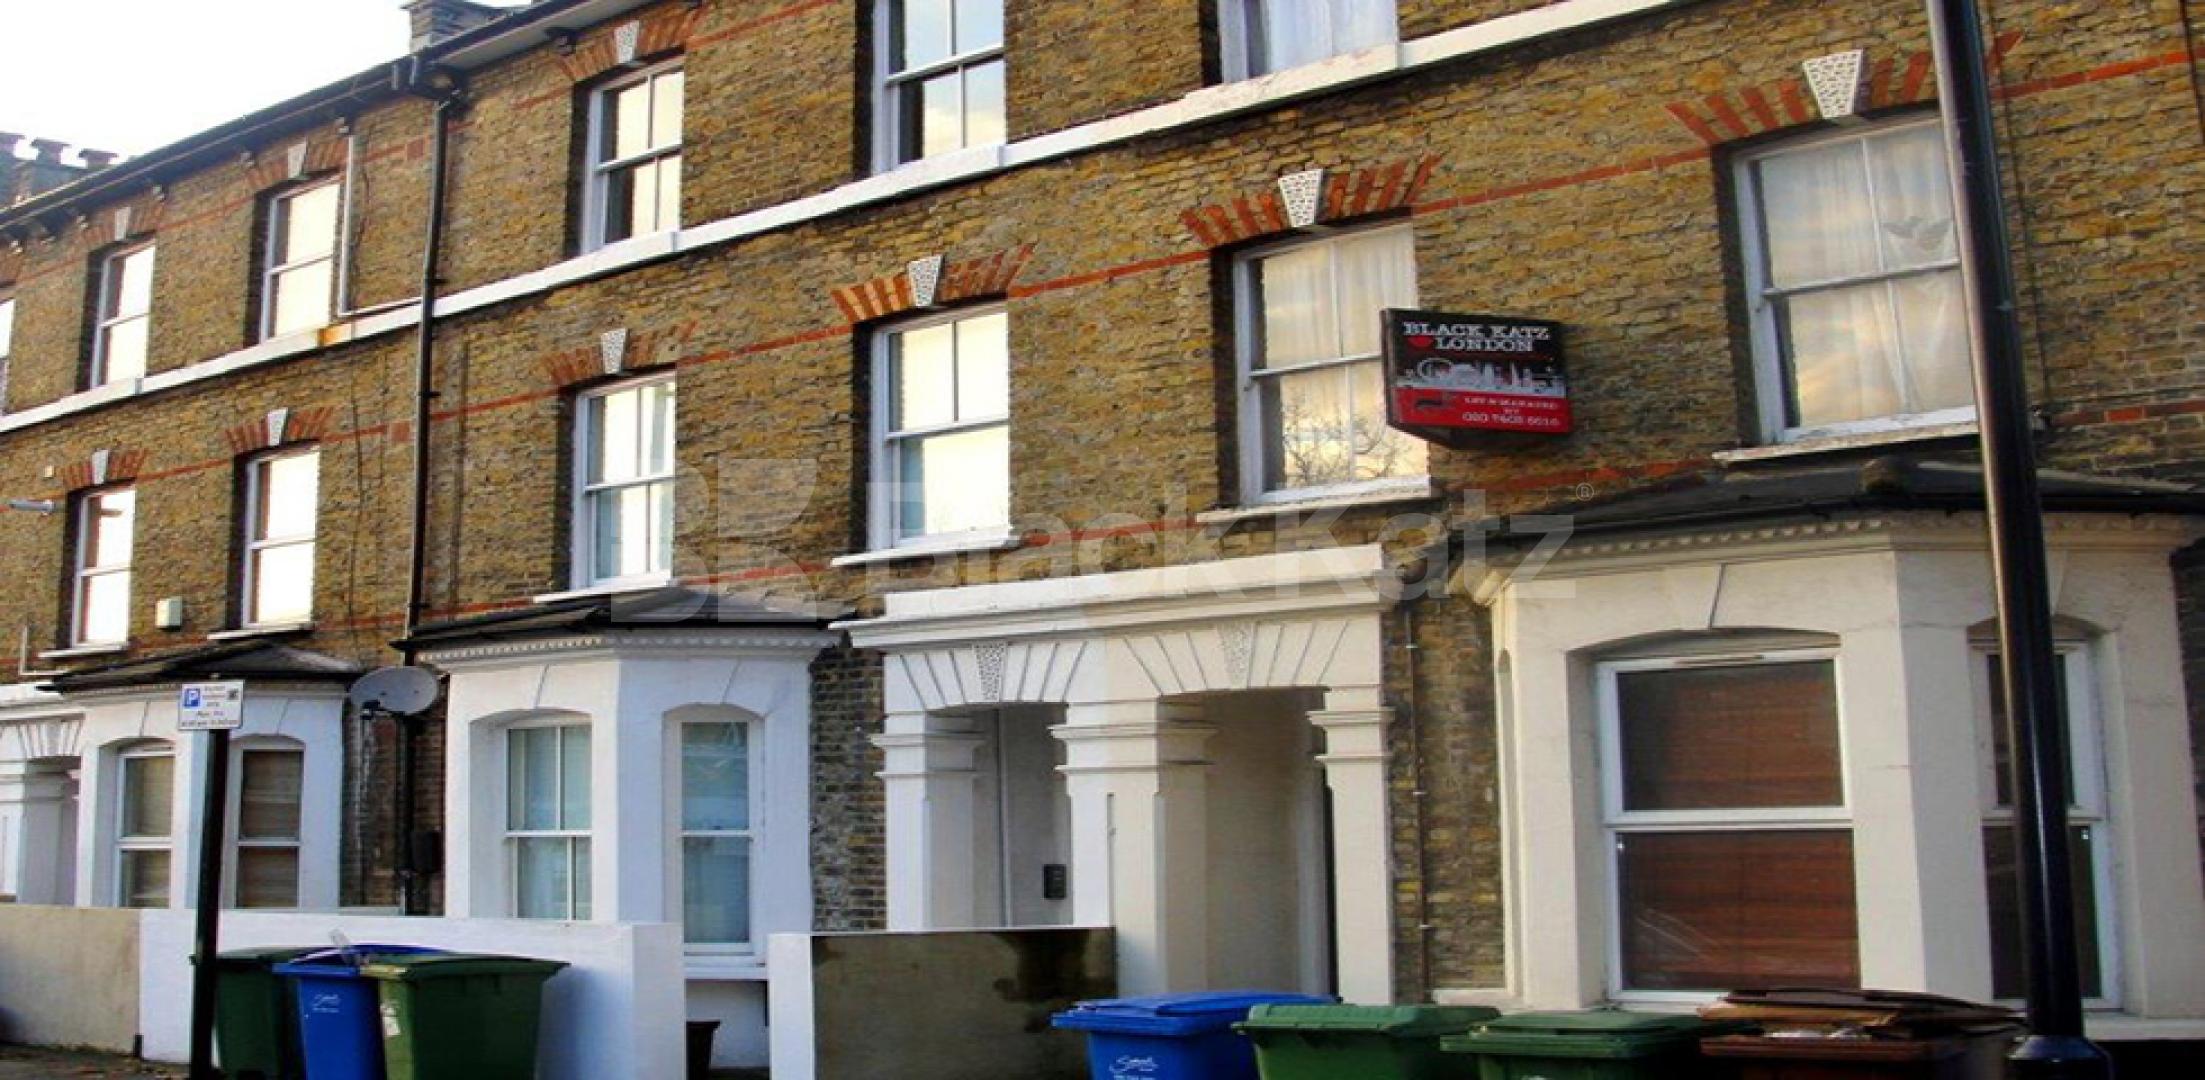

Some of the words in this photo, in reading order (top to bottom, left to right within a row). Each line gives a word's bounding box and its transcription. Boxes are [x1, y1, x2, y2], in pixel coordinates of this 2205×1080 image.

[1403, 322, 1485, 336] BLACK
[1490, 325, 1549, 341] KATZ
[1436, 336, 1532, 351] LONDON
